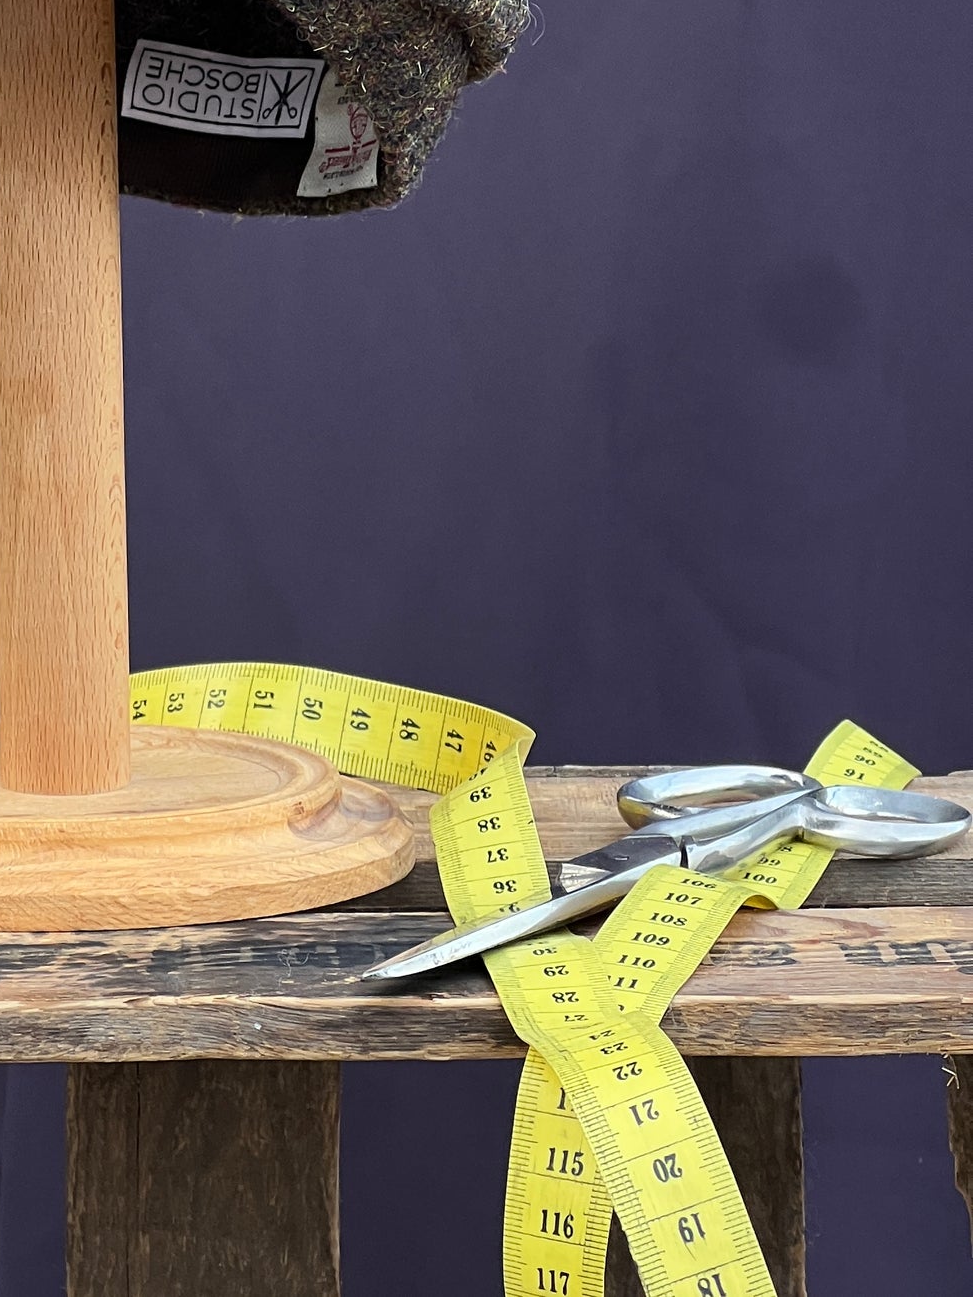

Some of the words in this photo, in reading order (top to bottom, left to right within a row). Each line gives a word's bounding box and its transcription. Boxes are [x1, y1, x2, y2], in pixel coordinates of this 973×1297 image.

[146, 56, 261, 94] BOSCHE
[142, 83, 258, 120] STUDIO
[132, 699, 148, 720] 54
[167, 691, 186, 714] 53
[208, 688, 227, 710] 52
[253, 689, 275, 711] 51
[301, 696, 324, 721] 50
[349, 707, 372, 732] 49
[398, 717, 422, 743] 48
[444, 728, 466, 754] 47
[854, 753, 876, 766] 90
[843, 767, 865, 781] 91
[469, 786, 492, 802] 39
[477, 816, 502, 833] 38
[487, 847, 509, 864] 37
[493, 879, 517, 894] 36
[679, 876, 718, 890] 106
[742, 871, 777, 885] 100
[663, 891, 702, 906] 107
[648, 912, 688, 927] 108
[630, 931, 670, 947] 109
[543, 965, 570, 978] 29
[617, 954, 656, 969] 110
[552, 991, 580, 1003] 28
[600, 1041, 629, 1055] 23
[612, 1061, 643, 1081] 22
[629, 1098, 660, 1126] 21
[546, 1147, 585, 1177] 115
[652, 1152, 684, 1183] 20
[540, 1208, 574, 1239] 116
[678, 1212, 707, 1244] 19
[536, 1267, 570, 1296] 117
[697, 1273, 728, 1297] 18
